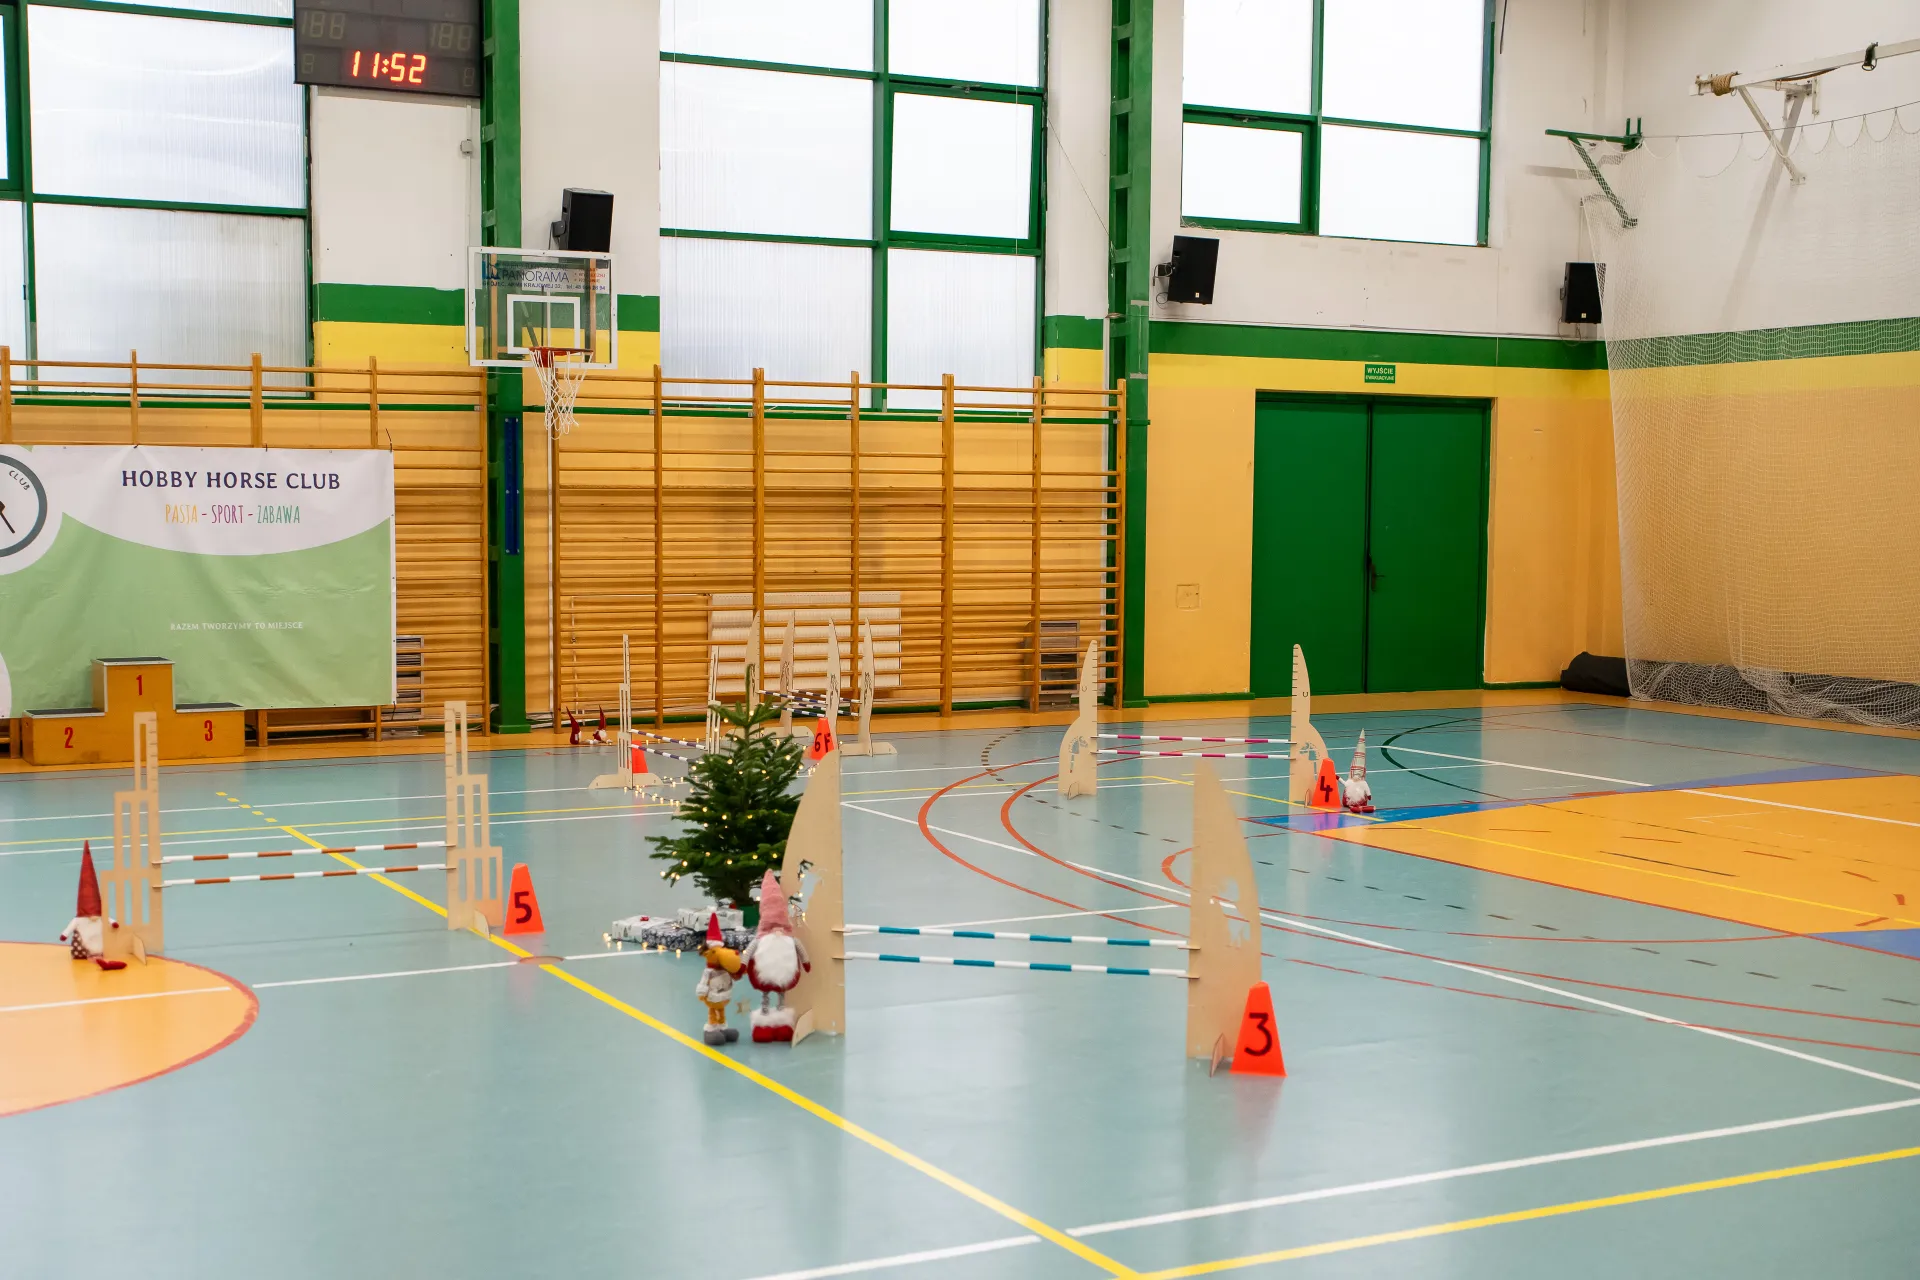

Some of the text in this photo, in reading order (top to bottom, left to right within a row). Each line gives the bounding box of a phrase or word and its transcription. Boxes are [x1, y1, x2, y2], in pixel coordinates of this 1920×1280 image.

[352, 50, 427, 84] 11:52
[502, 269, 570, 283] PANORAMA
[8, 470, 30, 491] CLUB
[122, 470, 341, 490] HOBBY HORSE CLUB
[165, 503, 198, 524] PASJA
[211, 504, 243, 524] SPORT
[257, 504, 300, 524] ZABAWA
[170, 621, 303, 631] RAZEM TWORZYMY TO MIEJSCE
[136, 674, 143, 696] 1
[64, 726, 74, 749] 2
[204, 719, 214, 742] 3
[1320, 775, 1334, 803] 4
[514, 890, 533, 924] 5
[1243, 1012, 1273, 1057] 3
